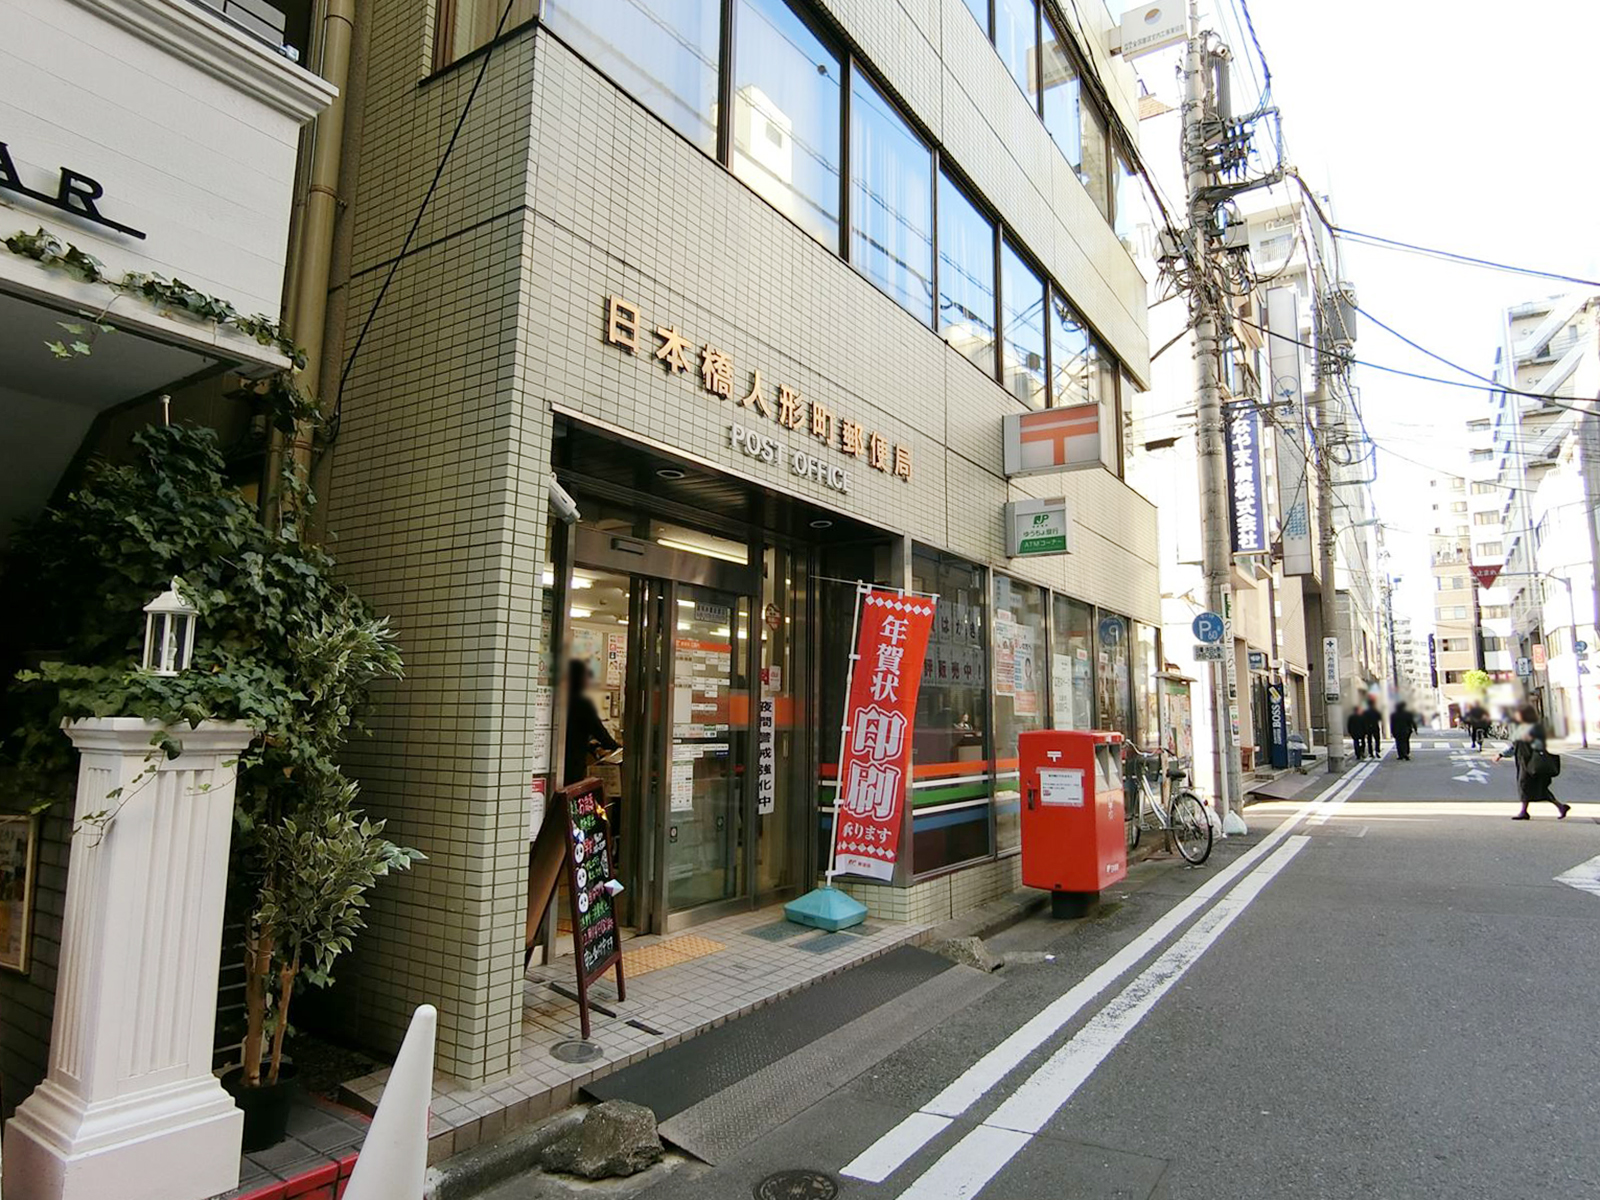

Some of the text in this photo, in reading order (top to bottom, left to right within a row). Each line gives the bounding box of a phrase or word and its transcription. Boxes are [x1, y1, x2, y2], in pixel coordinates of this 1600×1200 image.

[604, 294, 913, 482] 日本橋人形町郵便局
[730, 422, 853, 494] POST OFFICE
[1034, 514, 1049, 525] JP
[1023, 527, 1059, 537] ゆうちょ銀行
[1024, 539, 1062, 548] ATMコーナー
[931, 613, 976, 638] はがき
[1199, 620, 1212, 640] P
[1208, 631, 1218, 641] 60
[869, 614, 910, 703] 年賀状
[1271, 704, 1281, 728] BOSS
[759, 701, 773, 808] 夜間警戒強化中
[845, 704, 907, 821] 印刷
